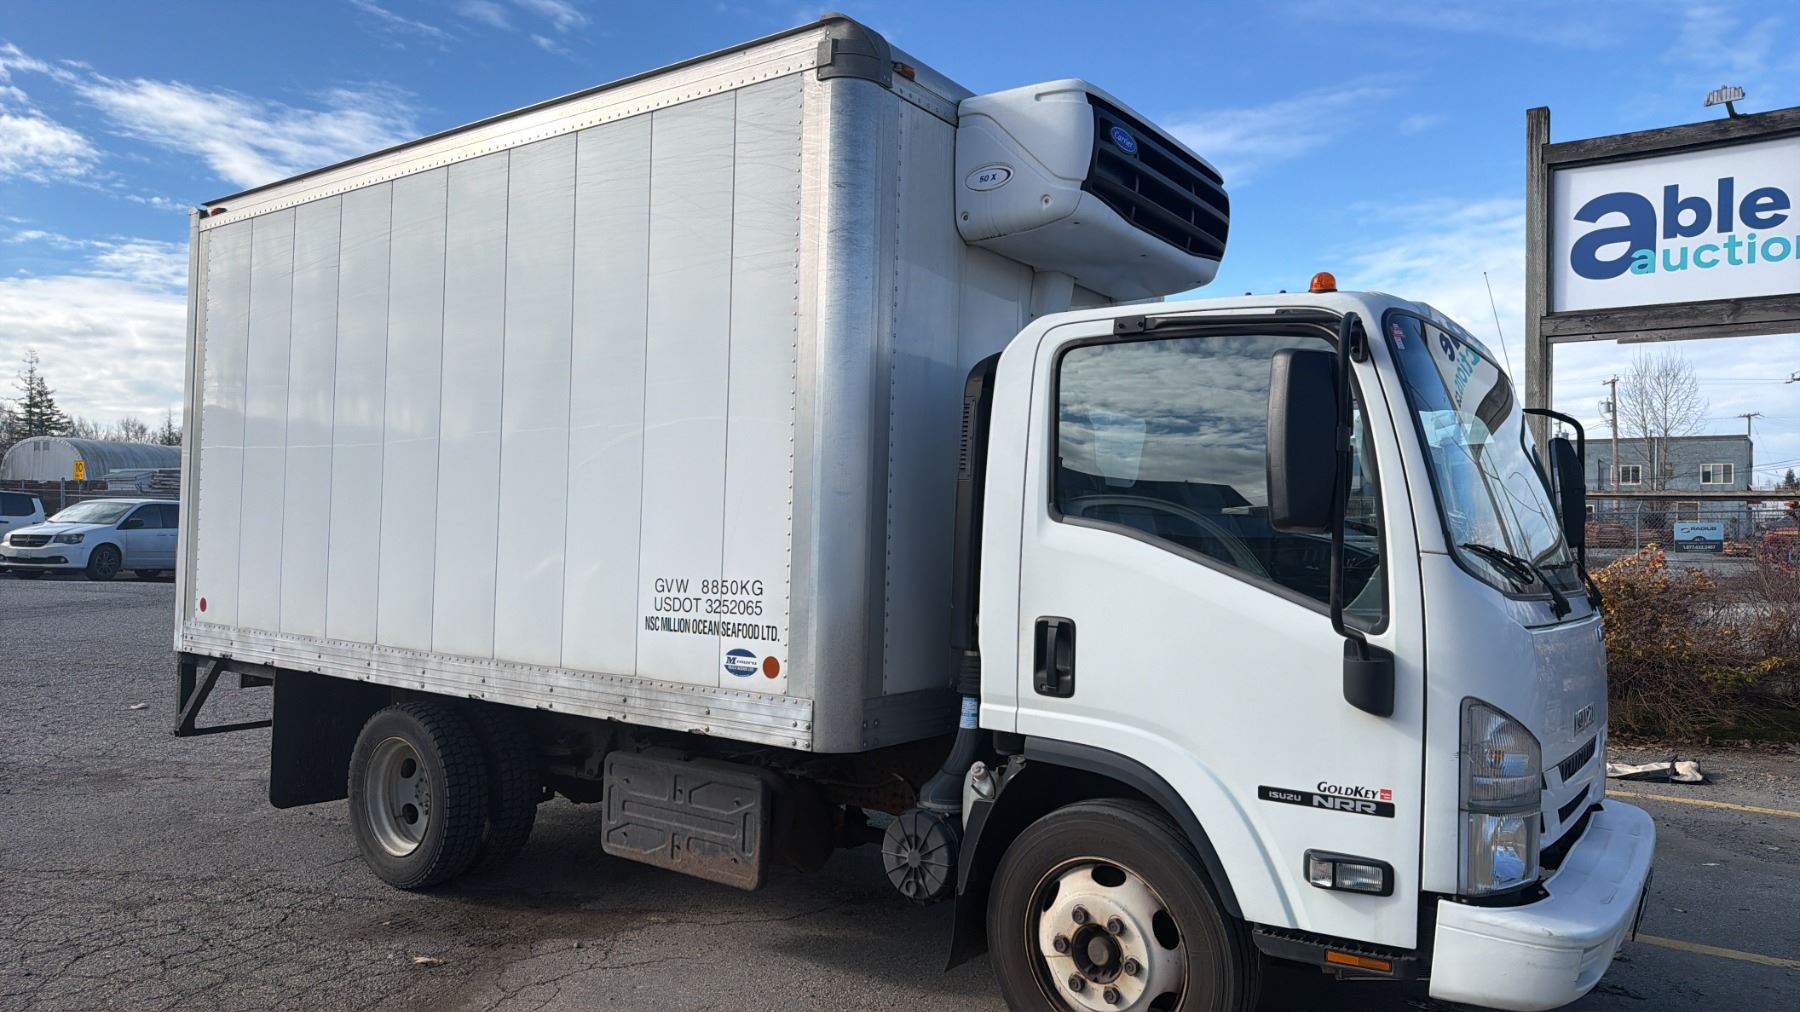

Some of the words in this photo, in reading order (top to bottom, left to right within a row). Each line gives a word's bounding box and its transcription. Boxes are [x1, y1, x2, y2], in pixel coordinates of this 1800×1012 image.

[979, 174, 990, 183] 50
[990, 172, 997, 181] X
[1570, 176, 1791, 280] able
[1630, 233, 1800, 275] auctio
[75, 463, 83, 472] 10
[654, 578, 689, 593] GVW
[701, 579, 764, 596] 8850KG
[654, 597, 702, 613] USDOT
[705, 599, 763, 616] 3252065
[645, 615, 660, 631] NSC
[661, 617, 691, 634] MILLION
[691, 619, 720, 636] OCEAN
[721, 621, 760, 640] SEAFOOD
[761, 625, 780, 642] LTD.
[1268, 790, 1301, 801] ISUZU
[1312, 795, 1377, 815] NRR
